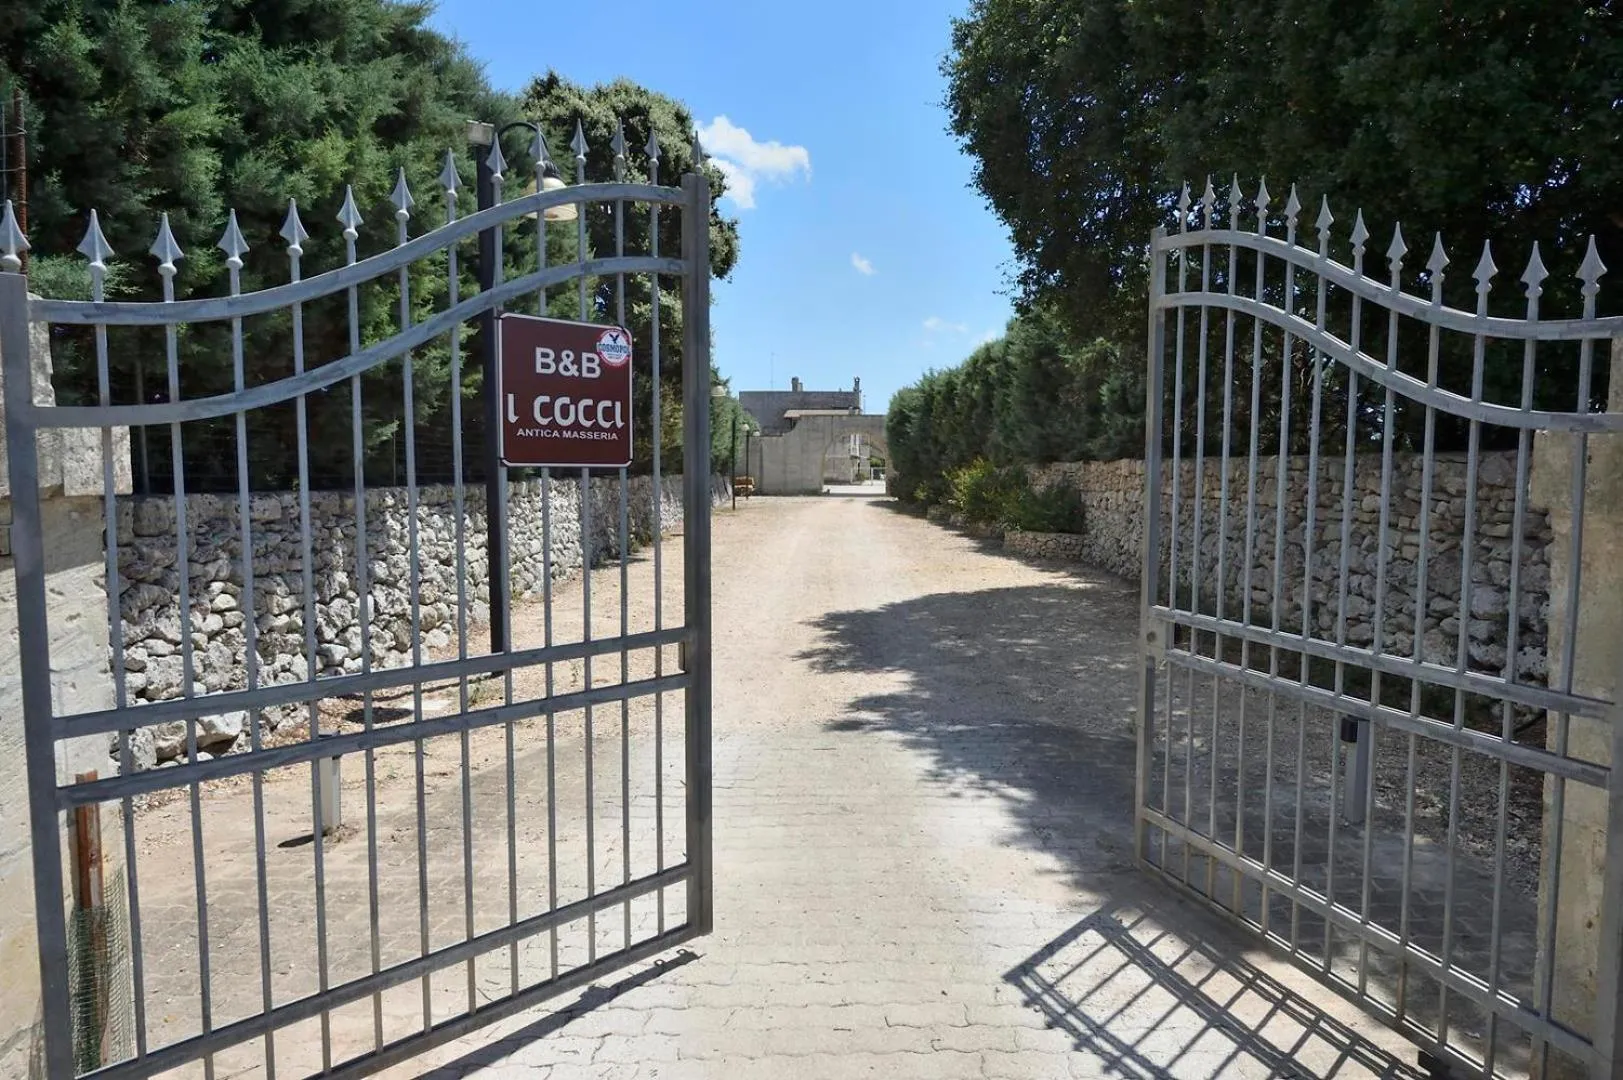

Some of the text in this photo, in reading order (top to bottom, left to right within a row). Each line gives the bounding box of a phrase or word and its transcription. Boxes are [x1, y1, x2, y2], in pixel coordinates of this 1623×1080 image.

[535, 347, 601, 378] B&B
[533, 395, 625, 429] COCCI
[516, 428, 619, 441] ANTICA MASSERIA
